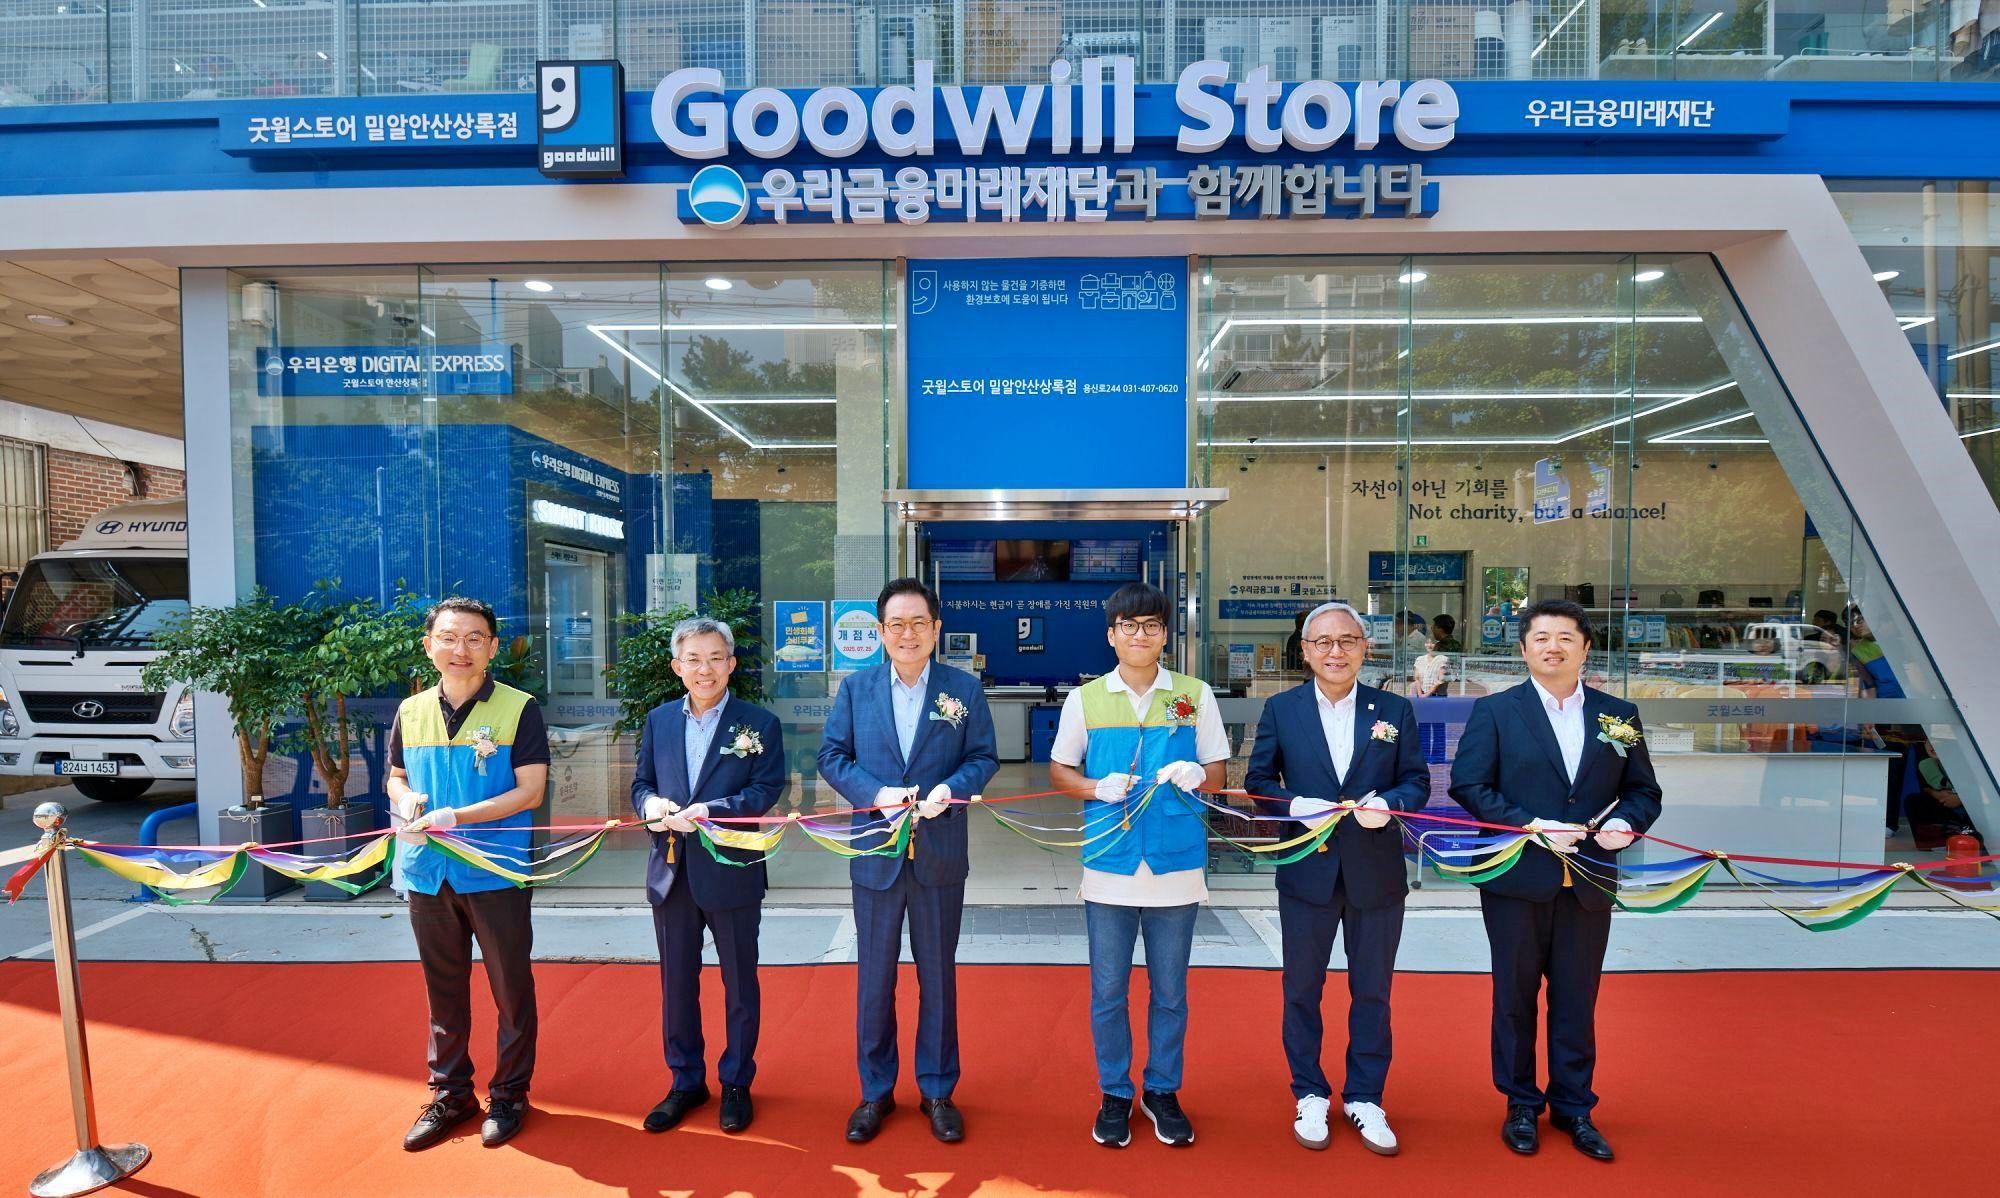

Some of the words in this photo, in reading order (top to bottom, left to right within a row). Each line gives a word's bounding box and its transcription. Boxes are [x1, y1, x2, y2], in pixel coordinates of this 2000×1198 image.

[651, 57, 1136, 159] Goodwill
[1176, 59, 1460, 155] Store
[1525, 98, 1715, 129] 우리금융미래재단
[248, 116, 357, 144] 굿윌스토어
[365, 110, 519, 142] 밀알안산상록점
[543, 146, 616, 168] goodwill
[757, 165, 1164, 226] 우리금융미래재단과
[1188, 163, 1429, 221] 함께합니다
[943, 280, 978, 291] 사용하지
[981, 280, 999, 291] 않는
[1001, 280, 1027, 291] 물건을
[1030, 280, 1066, 291] 기증하면
[965, 294, 1010, 305] 환경보호에
[1012, 294, 1039, 305] 도움이
[1042, 294, 1068, 305] 됩니다
[287, 355, 357, 374] 우리은행
[431, 354, 505, 373] EXPRESS
[343, 378, 384, 390] 굿윌스토어
[922, 379, 985, 395] 굿윌스토어
[989, 379, 1077, 395] 밀알안산상록점
[1083, 384, 1121, 394] 용신로244
[1123, 384, 1179, 394] 031-407-0620
[1351, 479, 1403, 499] 자선이
[1411, 479, 1446, 499] 아닌
[1456, 479, 1509, 499] 기회를
[1408, 503, 1442, 520] Not
[1450, 503, 1524, 523] charity,
[1534, 503, 1565, 520] but
[1571, 507, 1583, 519] a
[1591, 502, 1666, 520] chance!
[947, 600, 987, 610] 지불하시는
[990, 600, 1014, 610] 현금이
[1016, 600, 1025, 610] 곧
[1027, 600, 1051, 610] 장애를
[1054, 600, 1071, 610] 가진
[1073, 600, 1098, 610] 직원의
[1707, 704, 1765, 717] 굿윌스토어
[91, 763, 115, 773] 1453
